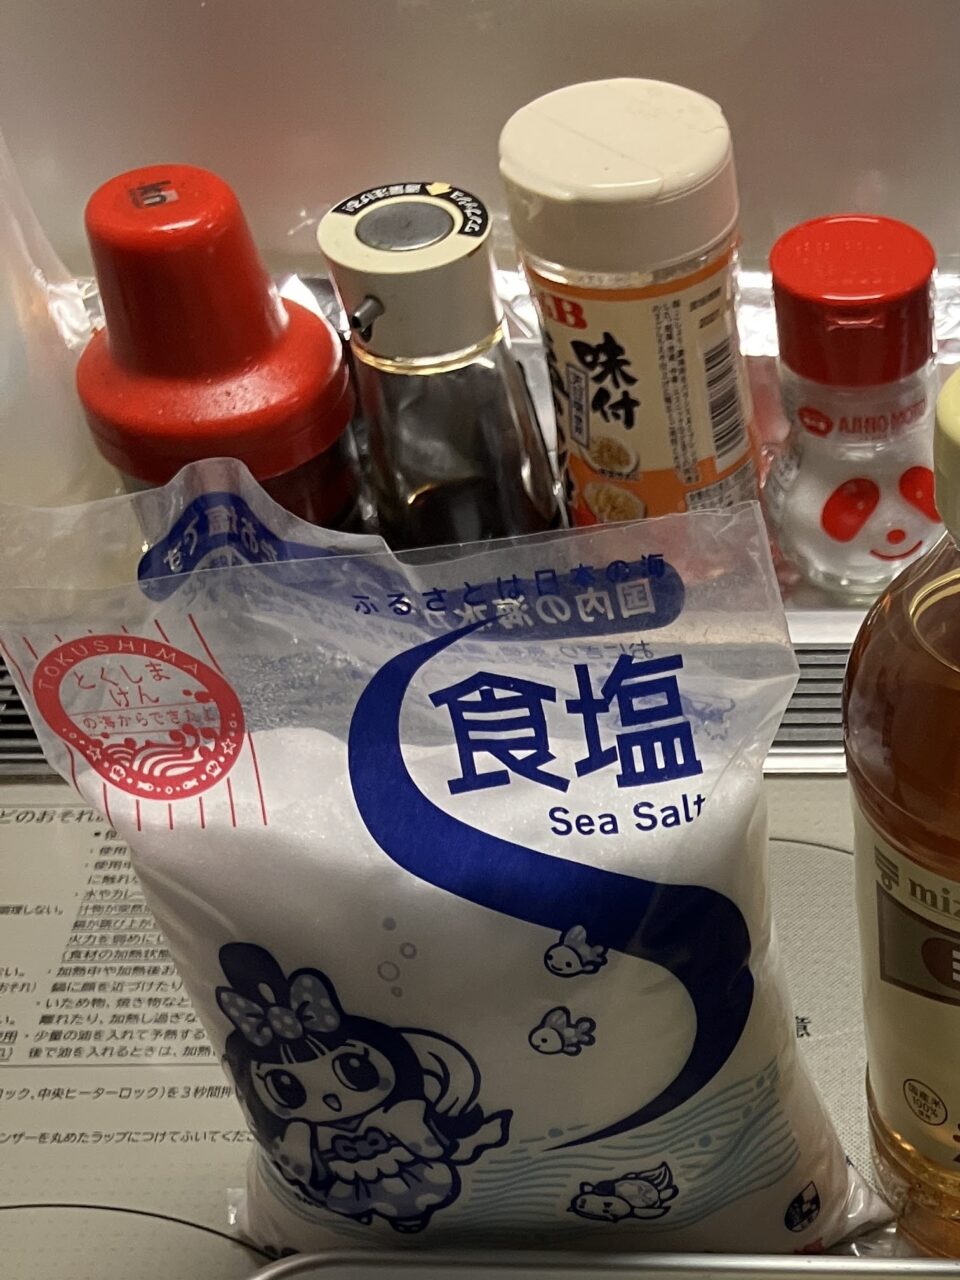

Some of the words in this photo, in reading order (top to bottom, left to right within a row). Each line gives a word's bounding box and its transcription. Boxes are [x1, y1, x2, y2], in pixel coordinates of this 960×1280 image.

[570, 331, 641, 430] 味付
[351, 553, 665, 616] ふるさとは日本の海
[38, 638, 200, 690] TOKUSHIMA
[74, 662, 171, 691] とくしま
[109, 685, 160, 708] けん
[428, 653, 704, 795] 食塩
[548, 806, 619, 836] Sea
[632, 793, 706, 832] Salt
